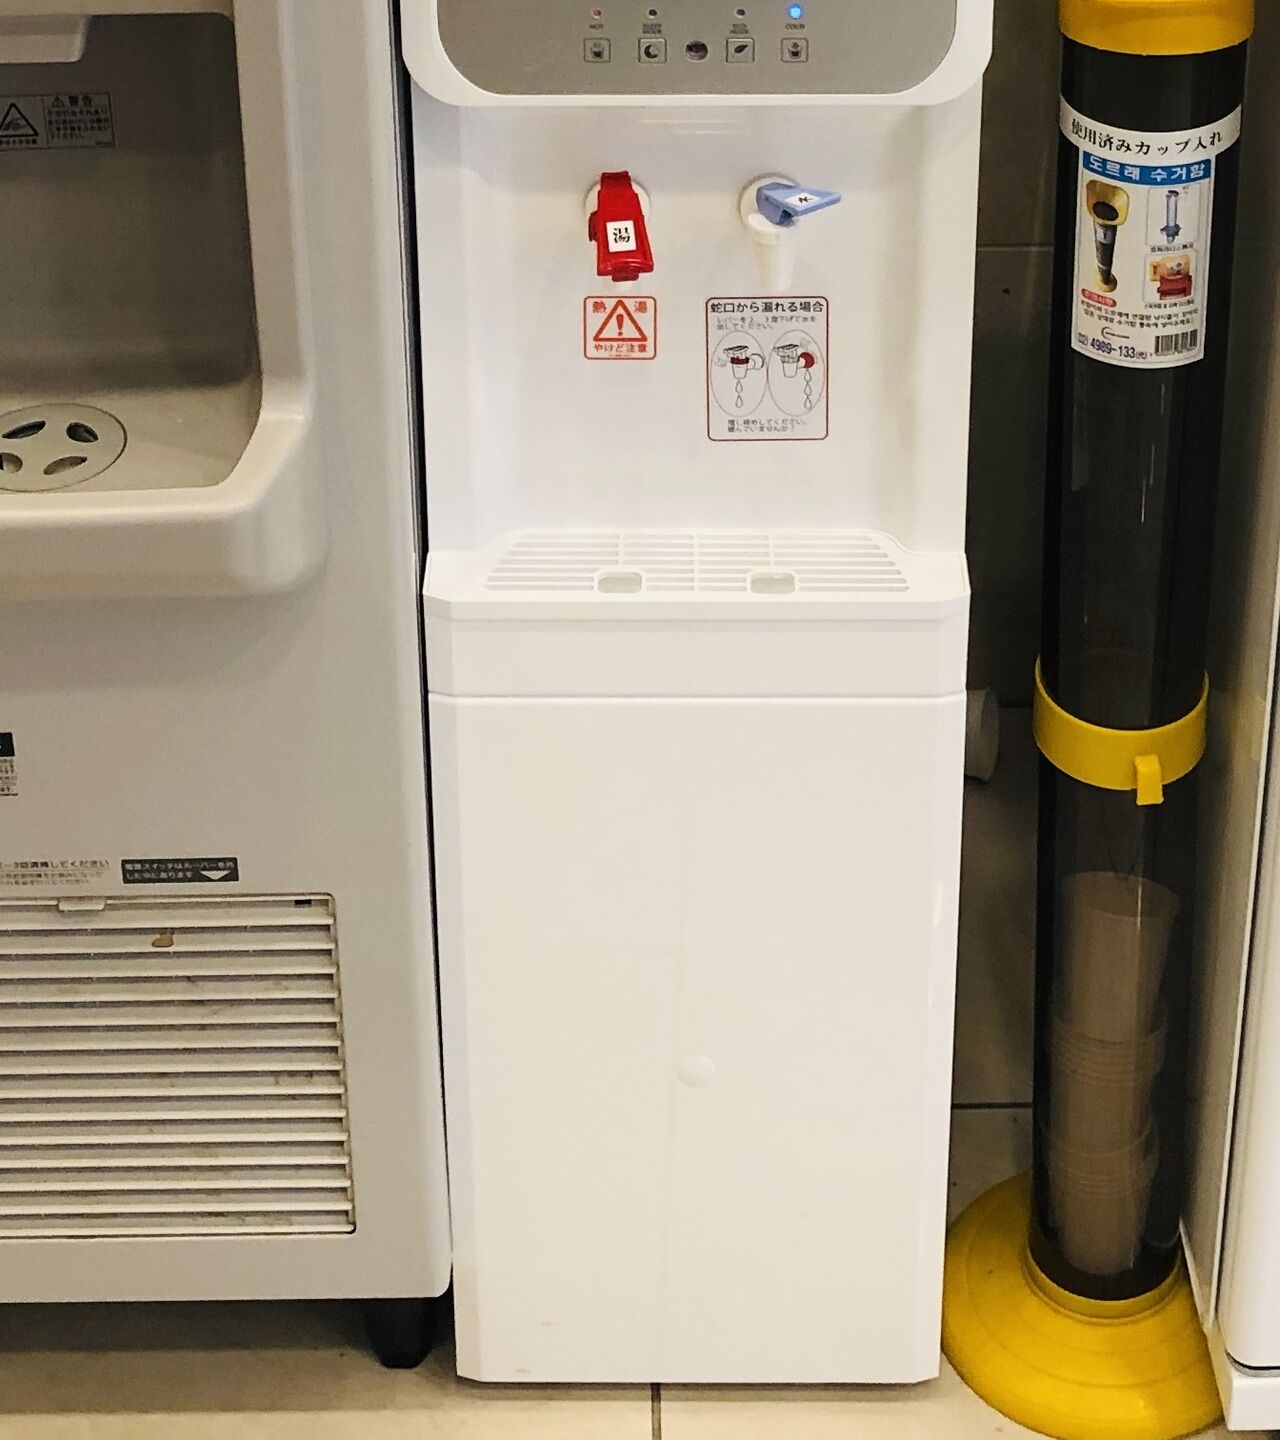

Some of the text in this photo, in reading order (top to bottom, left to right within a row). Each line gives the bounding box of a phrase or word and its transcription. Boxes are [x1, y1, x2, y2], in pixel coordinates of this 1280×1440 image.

[1071, 117, 1222, 155] 使用済みカップ入れ
[1088, 154, 1140, 181] 도르래
[593, 342, 648, 354] やけど注意
